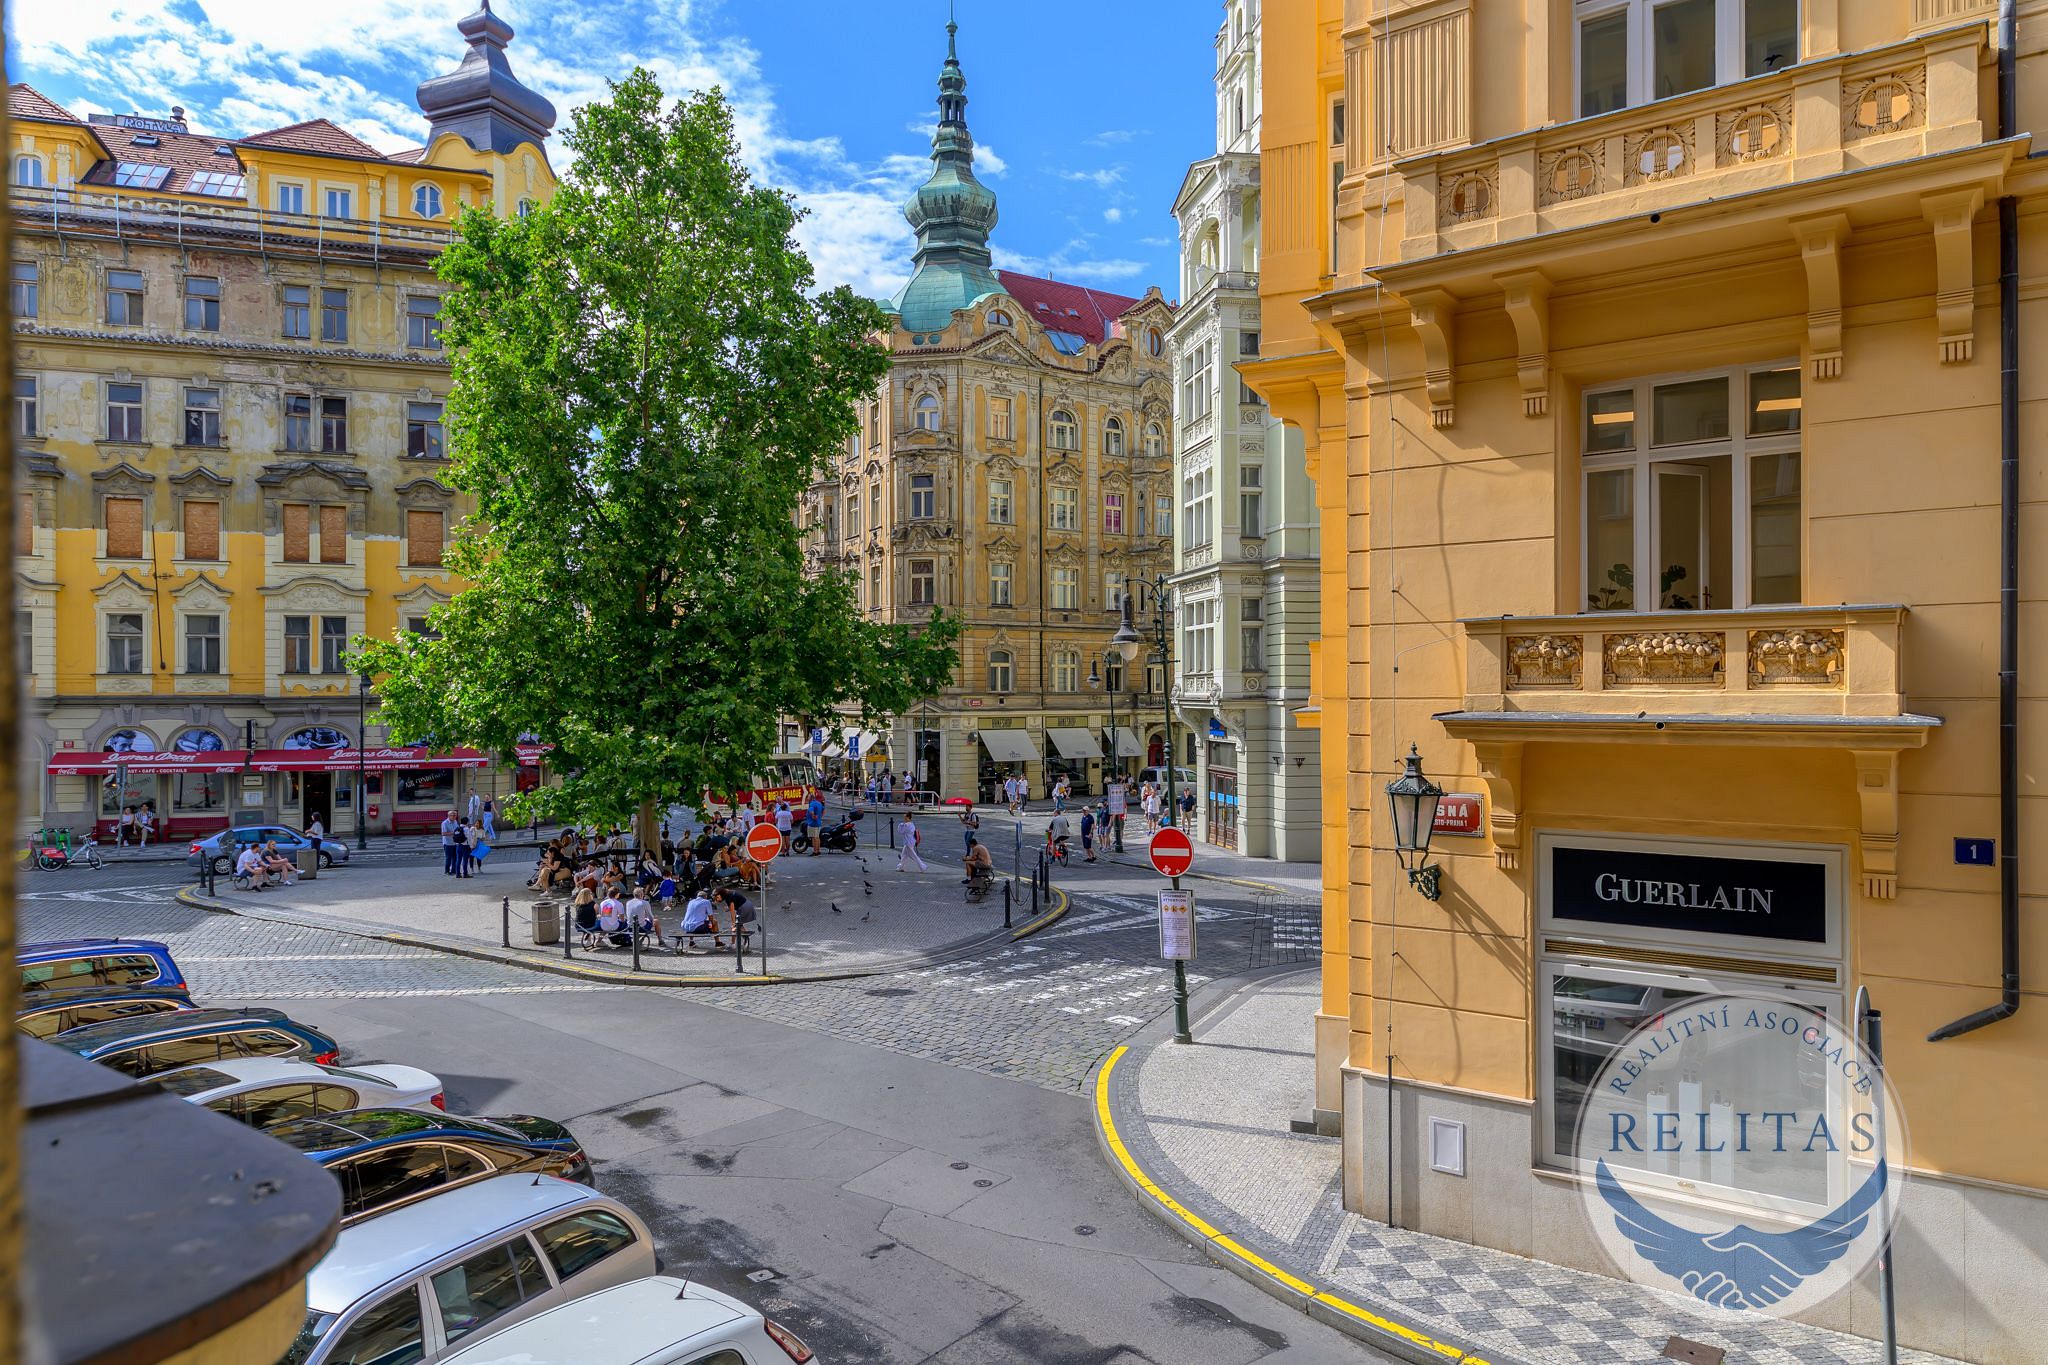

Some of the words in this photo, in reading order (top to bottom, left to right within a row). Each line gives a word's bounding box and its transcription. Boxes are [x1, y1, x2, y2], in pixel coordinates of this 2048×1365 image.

[783, 788, 802, 799] PRAGUE
[1436, 804, 1469, 818] SNÁ
[1970, 844, 1977, 859] 1
[1595, 873, 1774, 914] GUERLAIN
